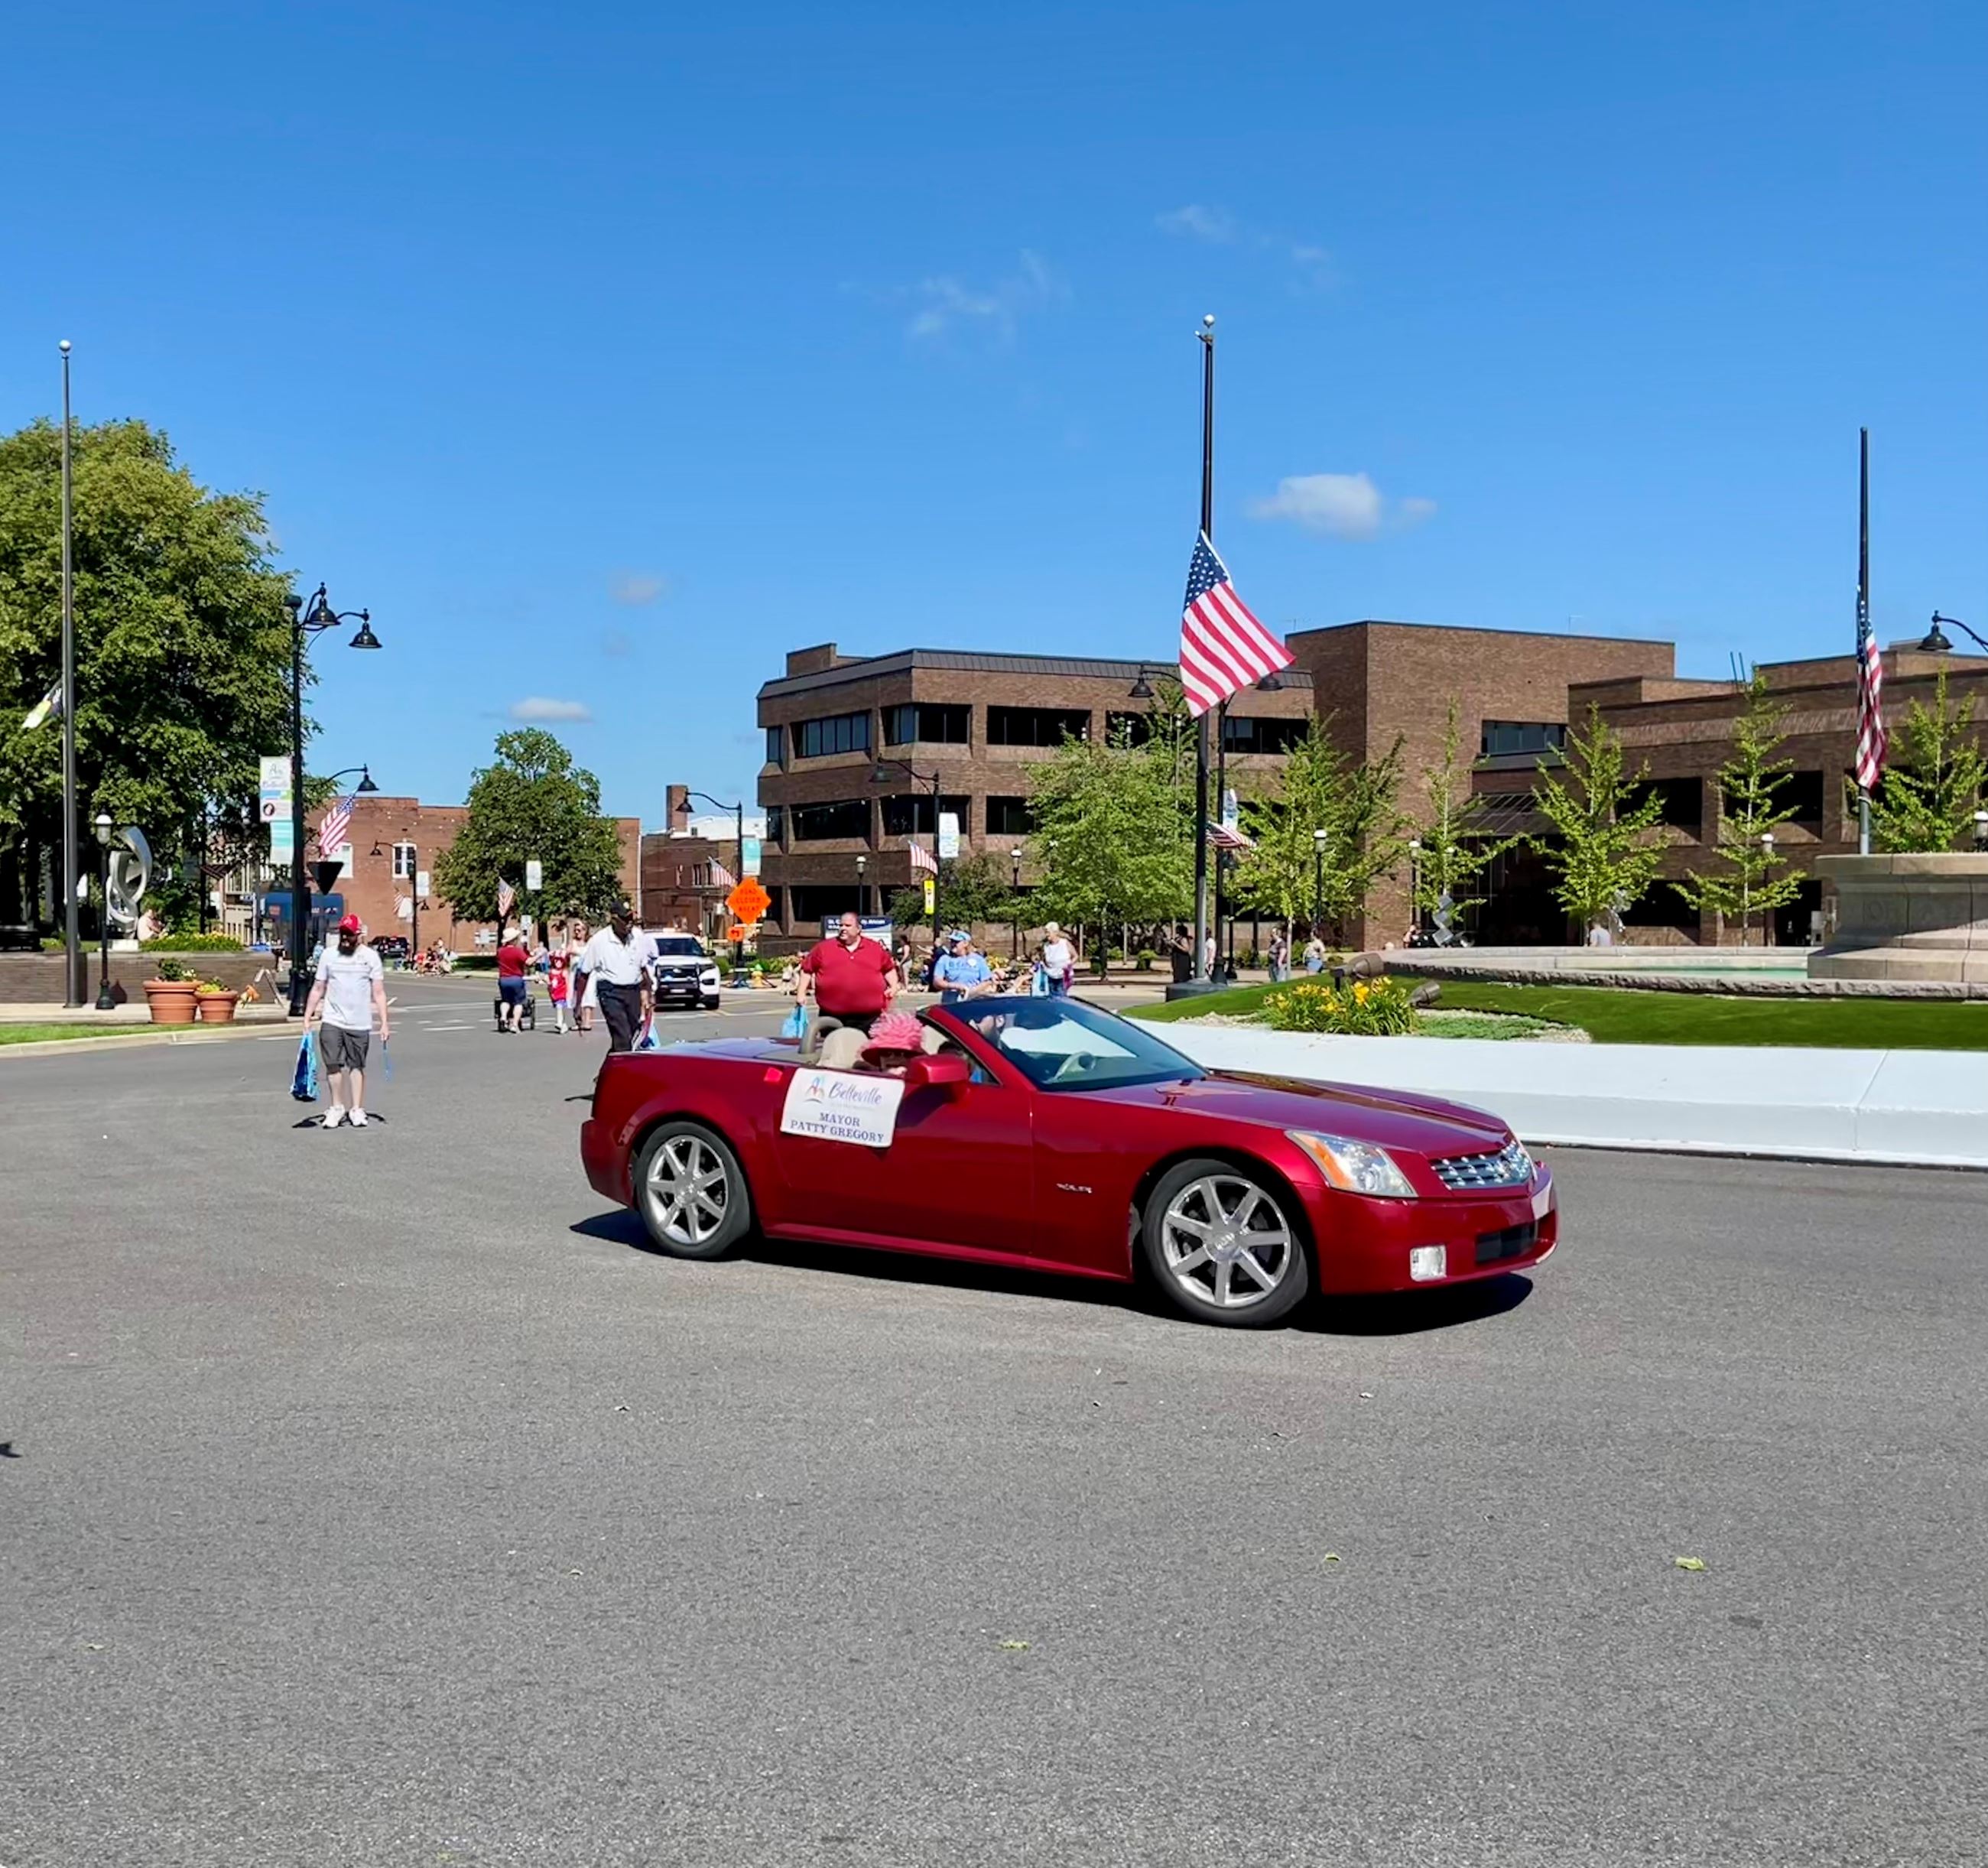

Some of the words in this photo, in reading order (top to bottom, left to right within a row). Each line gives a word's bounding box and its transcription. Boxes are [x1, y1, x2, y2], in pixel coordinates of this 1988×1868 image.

[829, 1081, 882, 1106] Belleville
[790, 1119, 829, 1133] PATTY
[830, 1127, 885, 1143] GREGORY
[820, 1112, 861, 1127] MAYOR
